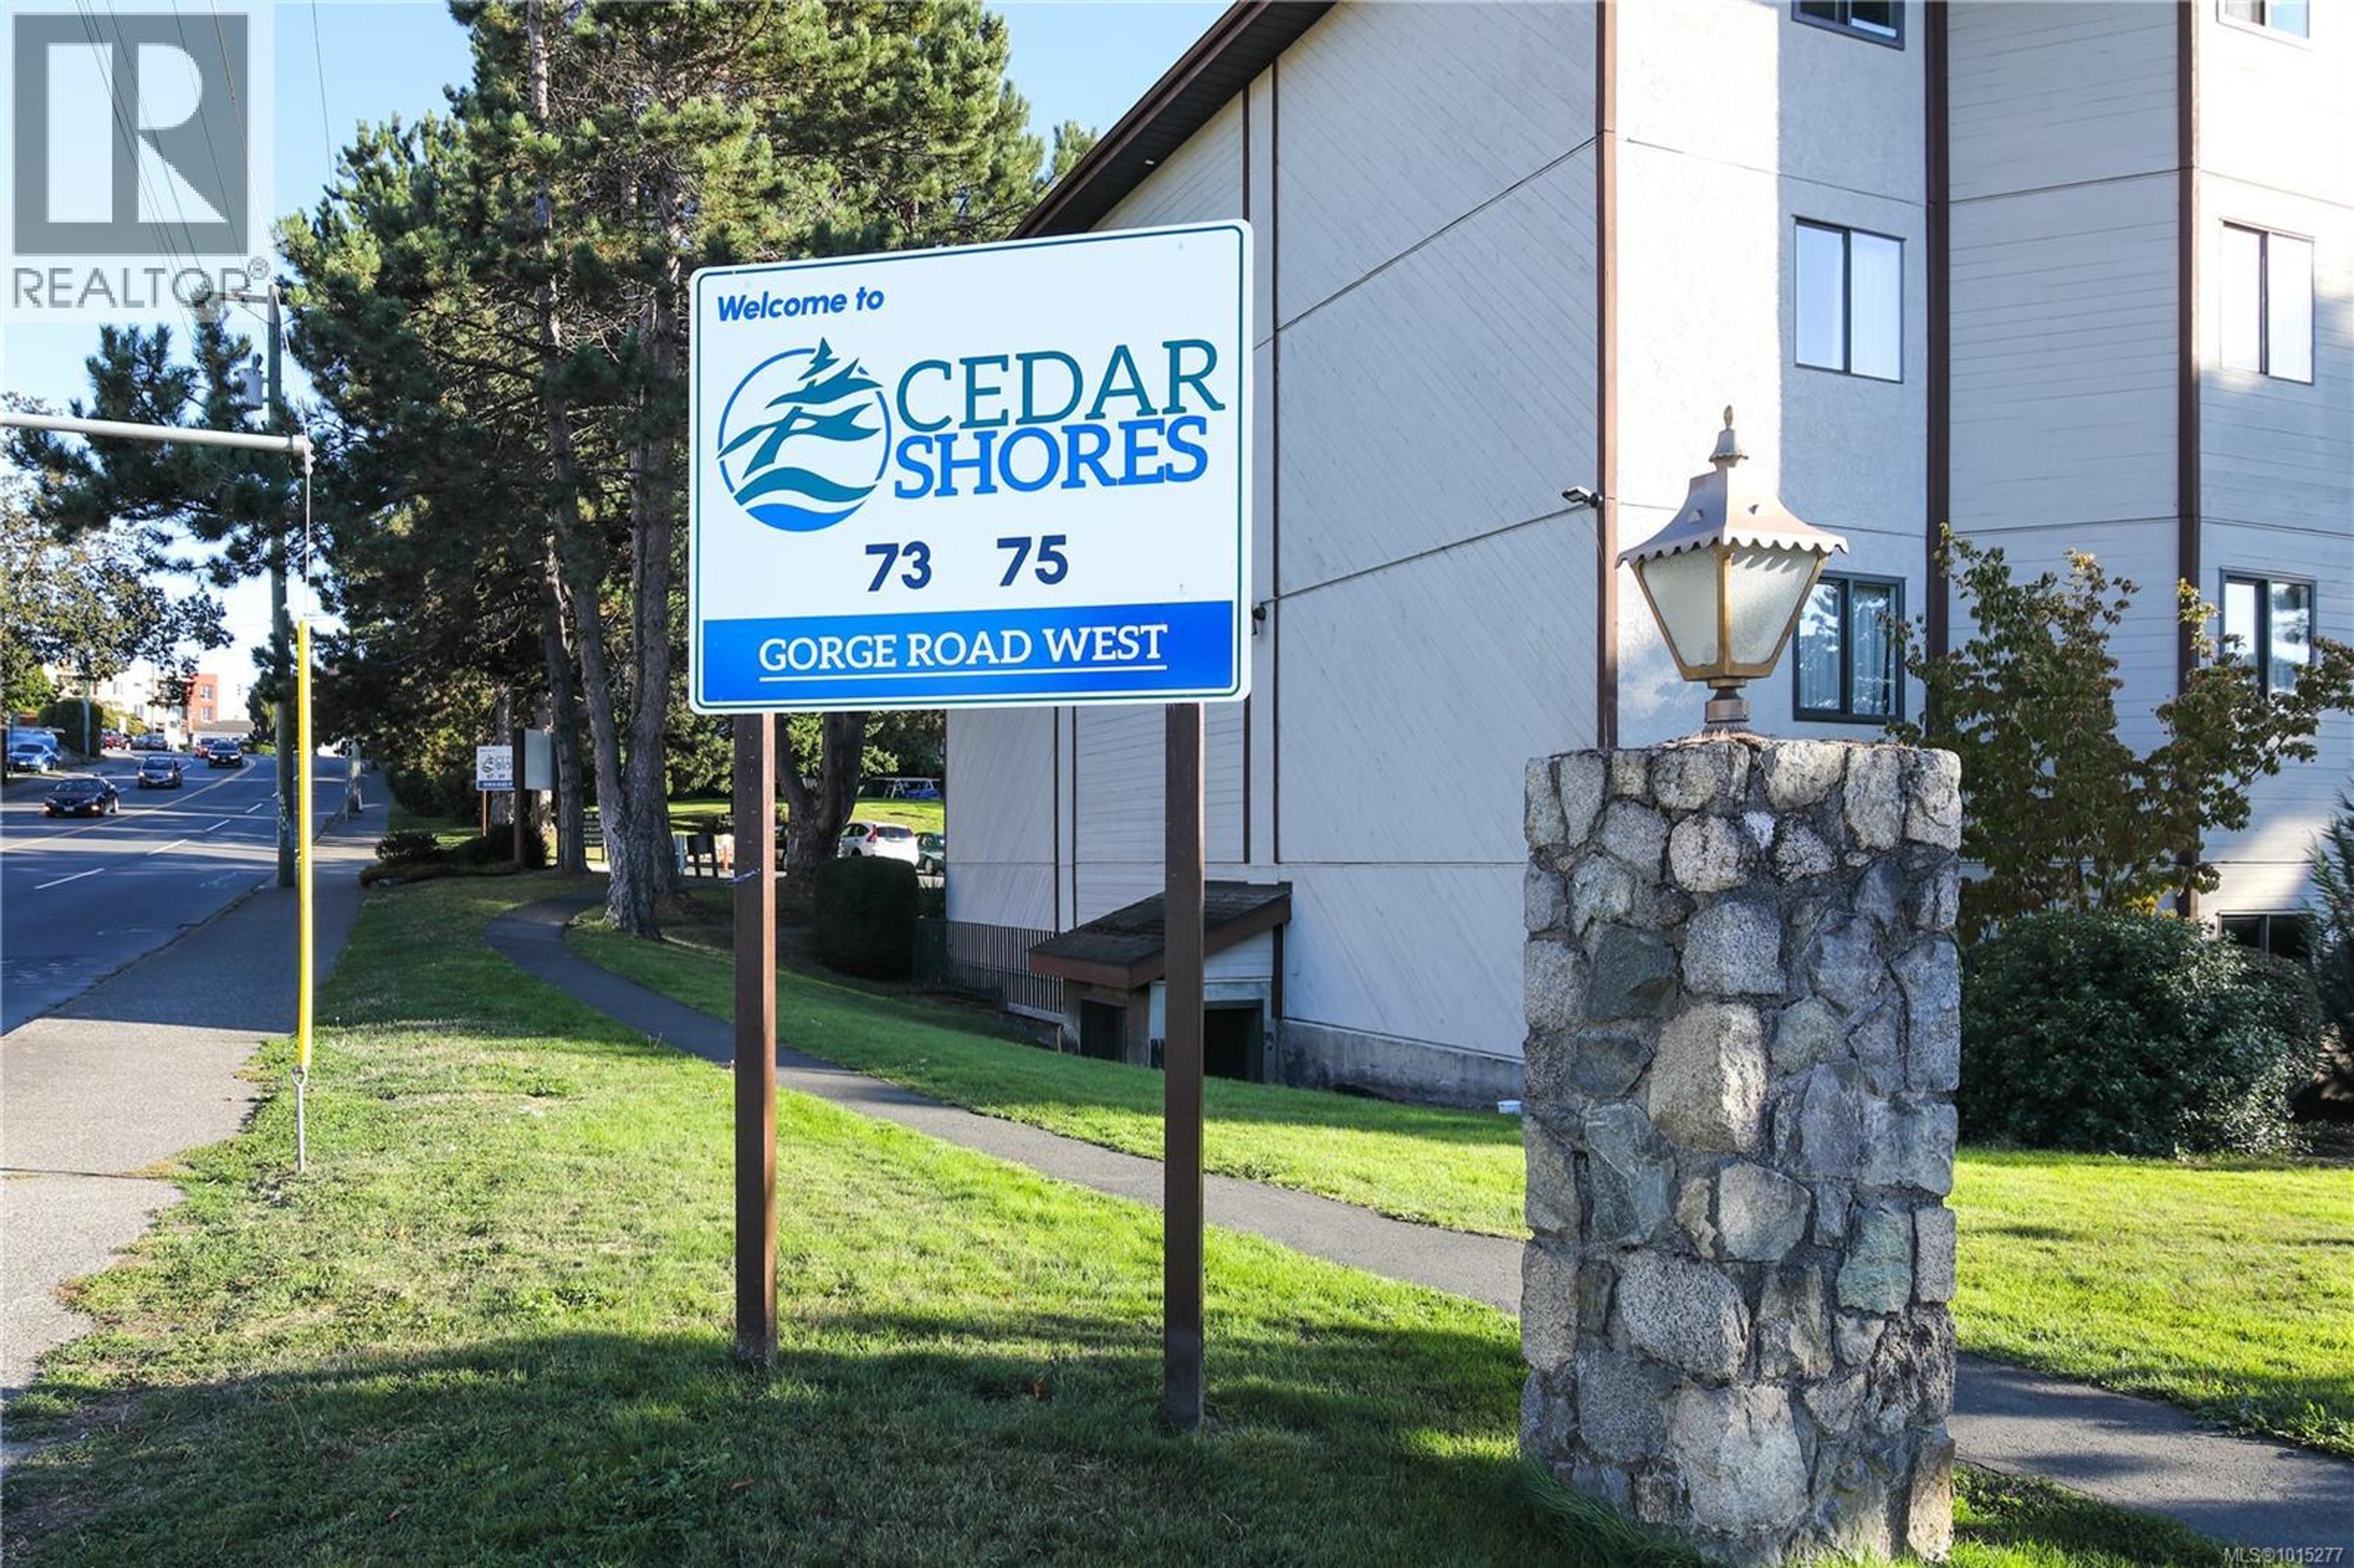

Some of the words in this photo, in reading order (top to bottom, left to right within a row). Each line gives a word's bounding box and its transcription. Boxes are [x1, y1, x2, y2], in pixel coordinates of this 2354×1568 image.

[718, 291, 847, 321] Welcome
[856, 286, 884, 311] to
[896, 338, 1225, 432] CEDAR
[895, 415, 1208, 499] SHORES
[865, 541, 932, 592] 73
[996, 535, 1068, 586] 75
[759, 633, 897, 671] GORGE
[907, 629, 1032, 667] ROAD
[1043, 623, 1168, 663] WEST
